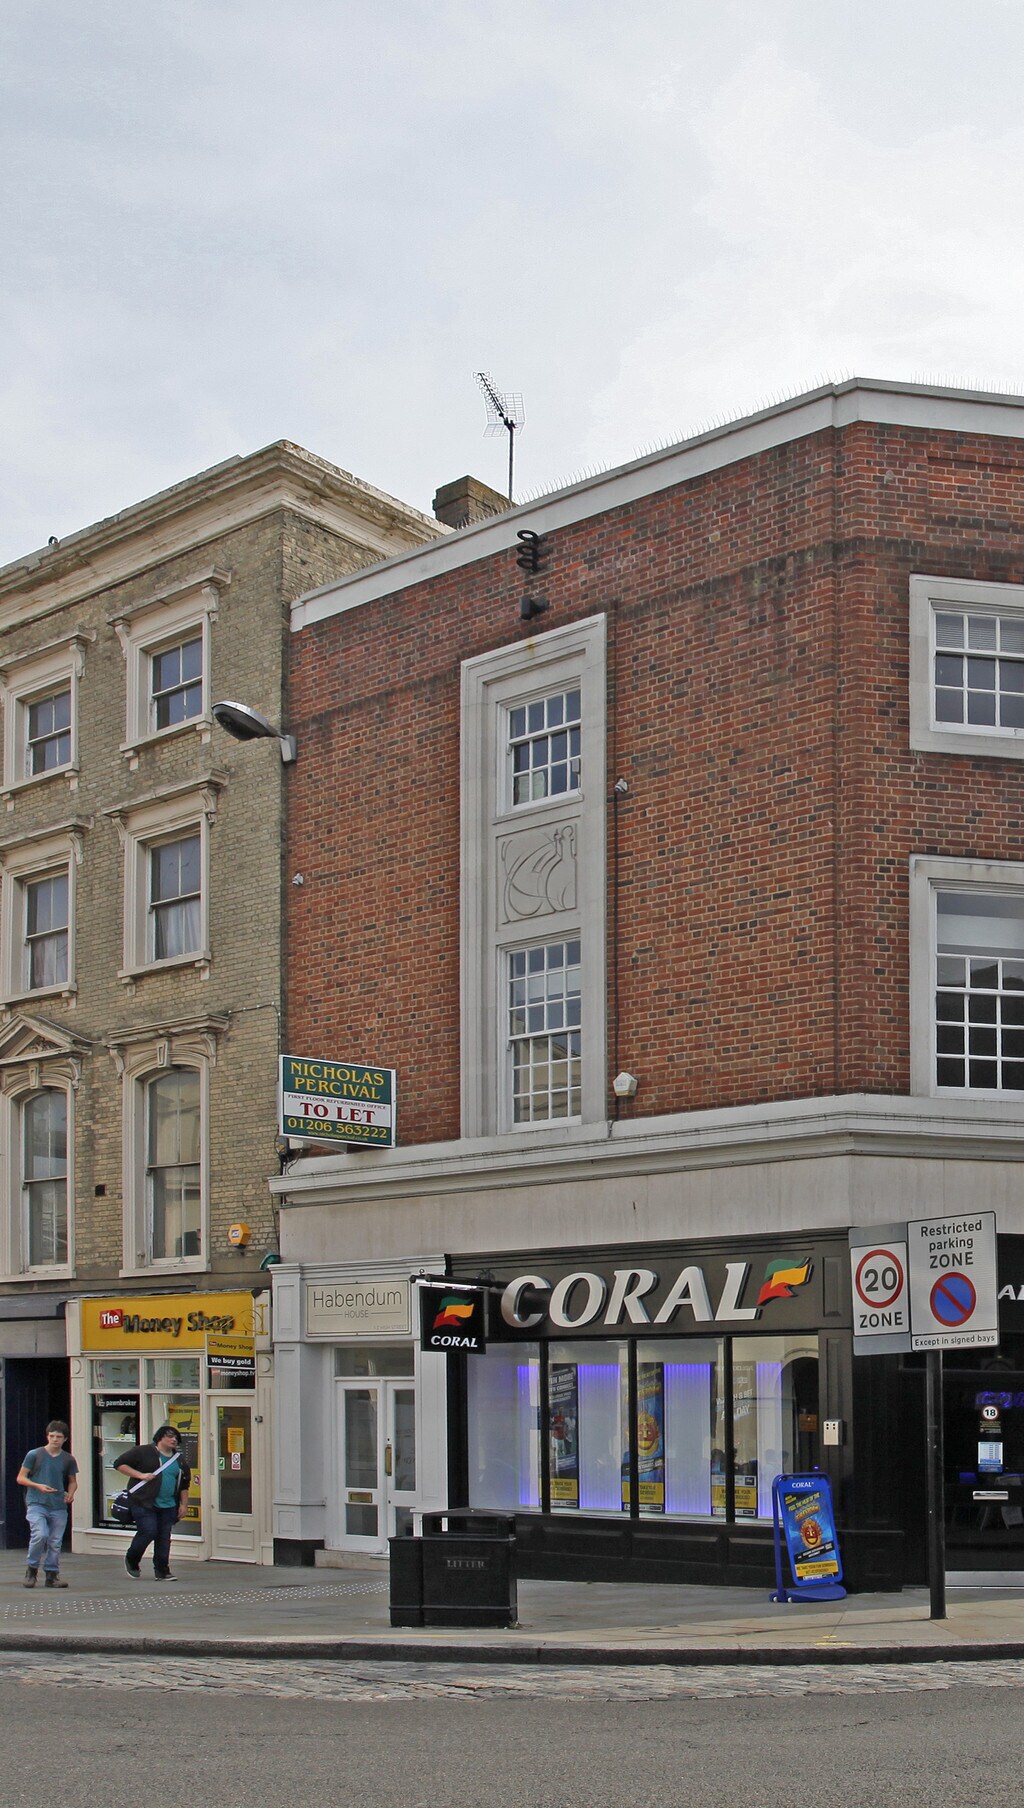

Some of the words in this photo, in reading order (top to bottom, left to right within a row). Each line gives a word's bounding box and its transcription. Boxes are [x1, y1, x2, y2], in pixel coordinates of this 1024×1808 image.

[290, 1062, 384, 1086] NICHOLAS
[294, 1077, 381, 1099] PERCIVAL
[300, 1102, 329, 1118] TO
[336, 1106, 376, 1123] LET
[287, 1117, 333, 1132] 01206
[336, 1123, 388, 1138] 563222
[920, 1219, 982, 1237] Restricted
[929, 1237, 974, 1252] parking
[929, 1251, 974, 1269] ZONE
[864, 1266, 898, 1292] 20
[313, 1287, 402, 1308] Habendum
[500, 1262, 761, 1329] CORAL
[344, 1309, 369, 1318] HOUSE
[859, 1311, 903, 1328] ZONE
[101, 1313, 120, 1325] The
[123, 1313, 183, 1338] Money
[187, 1310, 235, 1335] Shop
[430, 1335, 478, 1348] CORAL
[914, 1338, 940, 1347] Except
[941, 1336, 949, 1344] in
[950, 1334, 975, 1345] signed
[977, 1332, 995, 1343] bays
[223, 1357, 235, 1366] buy
[236, 1358, 251, 1366] gold
[105, 1398, 137, 1407] pawnbroker
[984, 1408, 996, 1417] 18
[447, 1559, 487, 1568] LITTER
